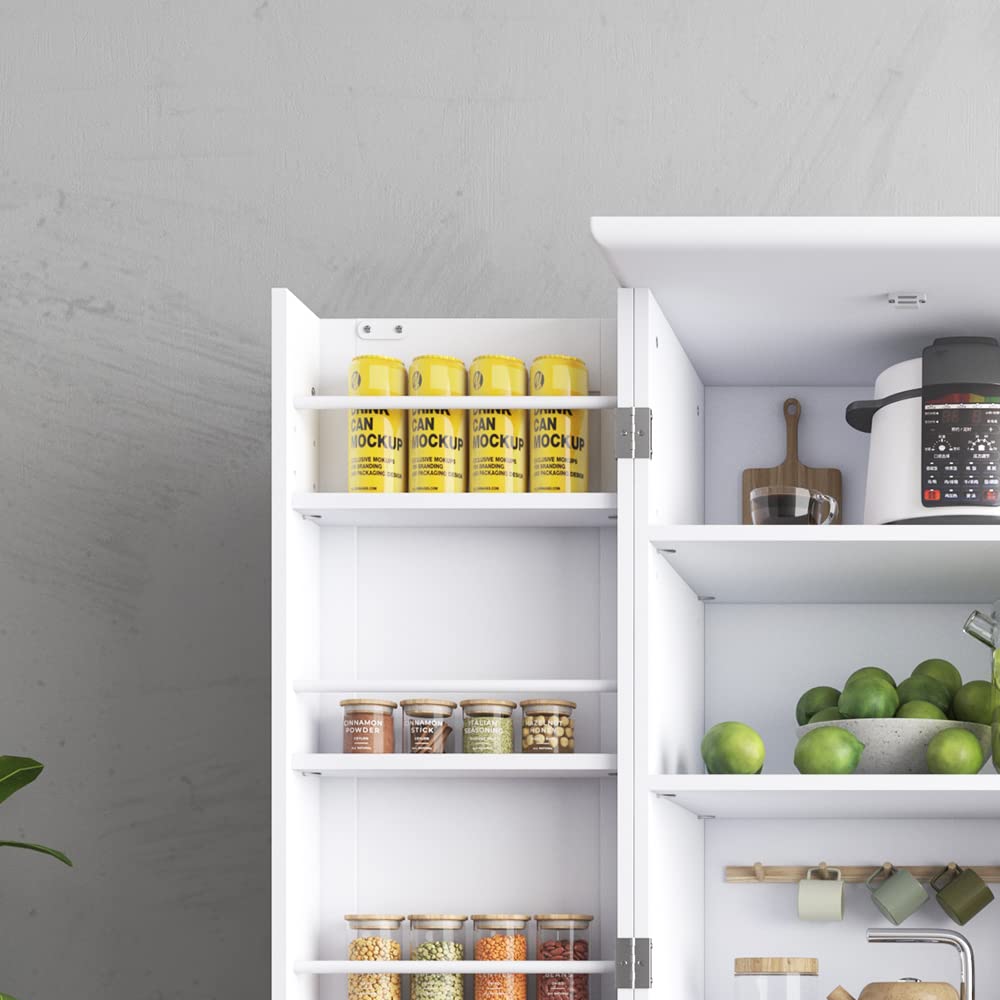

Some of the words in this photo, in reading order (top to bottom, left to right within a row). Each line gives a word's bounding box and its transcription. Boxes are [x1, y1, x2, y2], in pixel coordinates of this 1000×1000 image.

[352, 417, 373, 432] CAN
[412, 417, 434, 432] CAN
[473, 417, 495, 432] CAN
[534, 417, 556, 432] CAN
[352, 434, 403, 451] MOCKUP
[412, 434, 463, 451] MOCKUP
[473, 434, 524, 451] MOCKUP
[534, 434, 584, 451] MOCKUP
